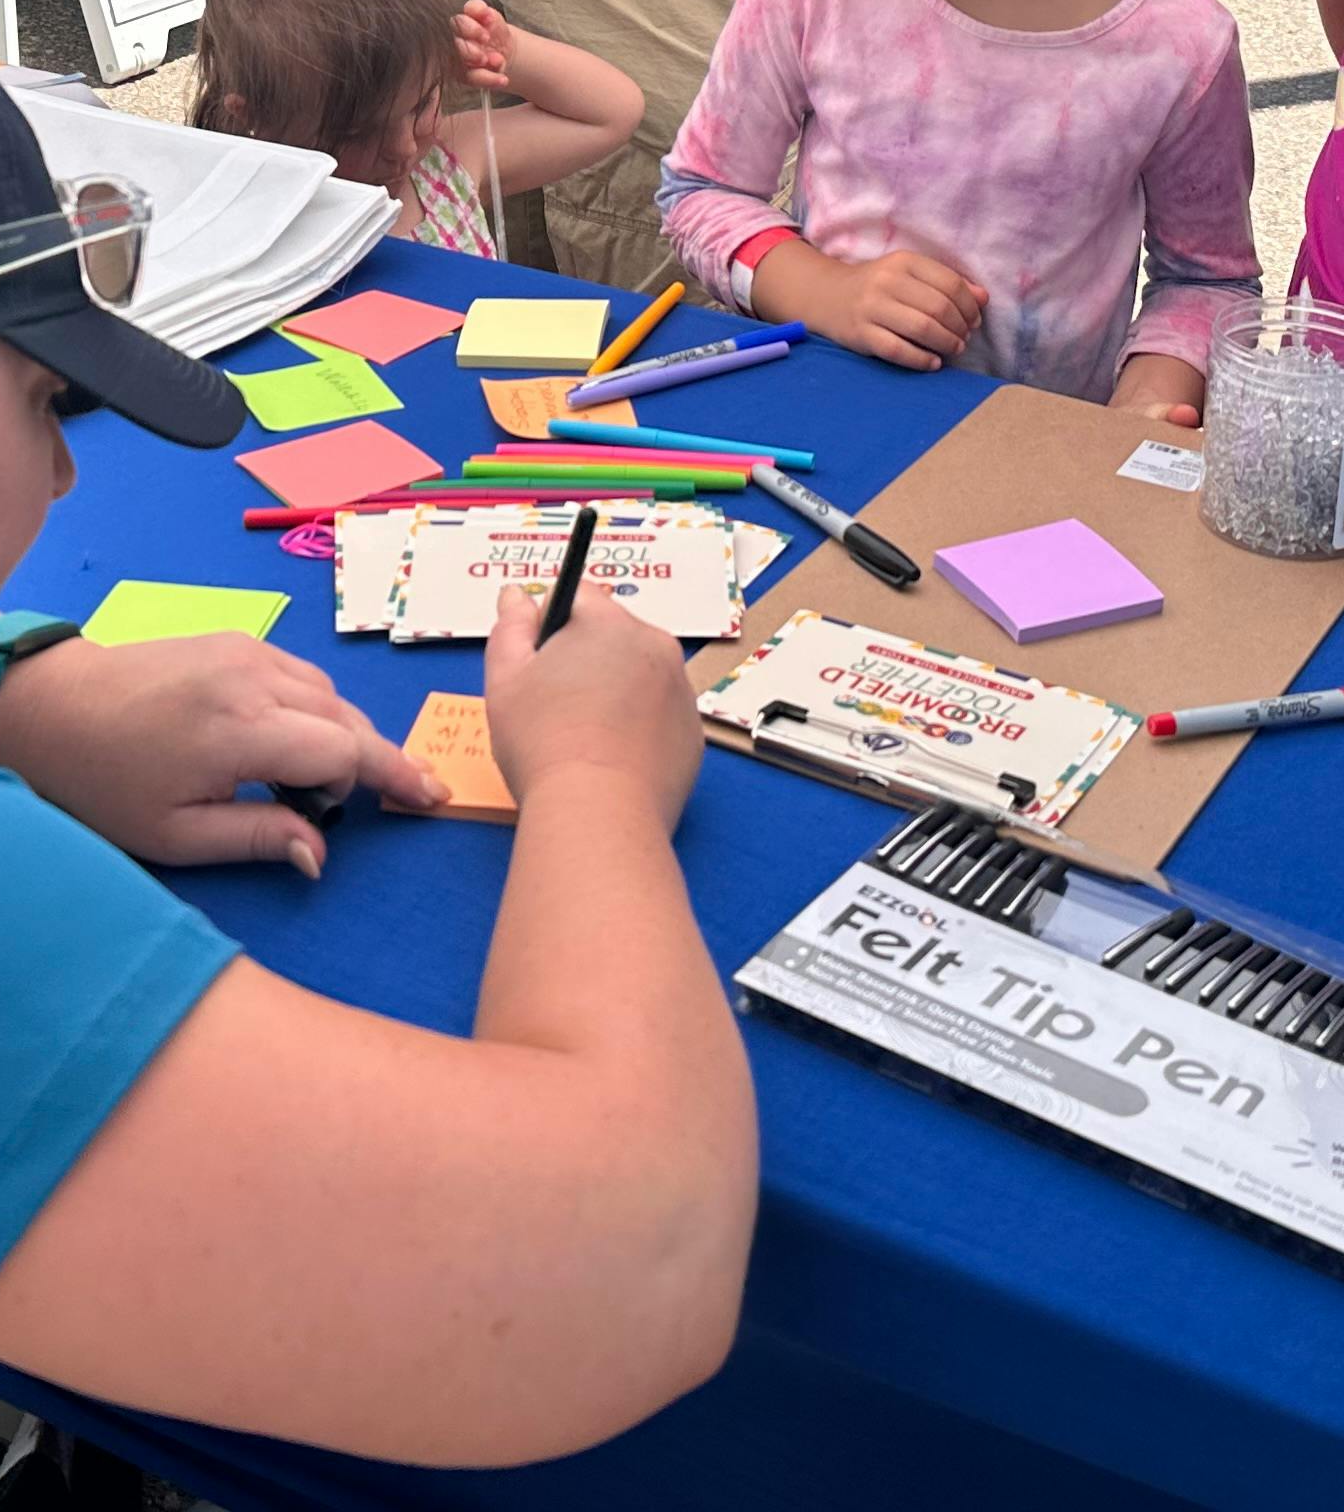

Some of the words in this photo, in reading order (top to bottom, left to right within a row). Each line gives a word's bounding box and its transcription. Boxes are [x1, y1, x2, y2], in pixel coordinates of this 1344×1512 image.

[468, 562, 672, 580] BROOFIELD
[488, 545, 653, 563] TOGTHER
[819, 666, 1027, 742] BROOMFIELD
[850, 656, 1017, 717] TOGETHER
[821, 902, 964, 986] Felt
[981, 967, 1096, 1041] Tip
[1113, 1027, 1267, 1119] Pen
[928, 999, 965, 1027] Quick
